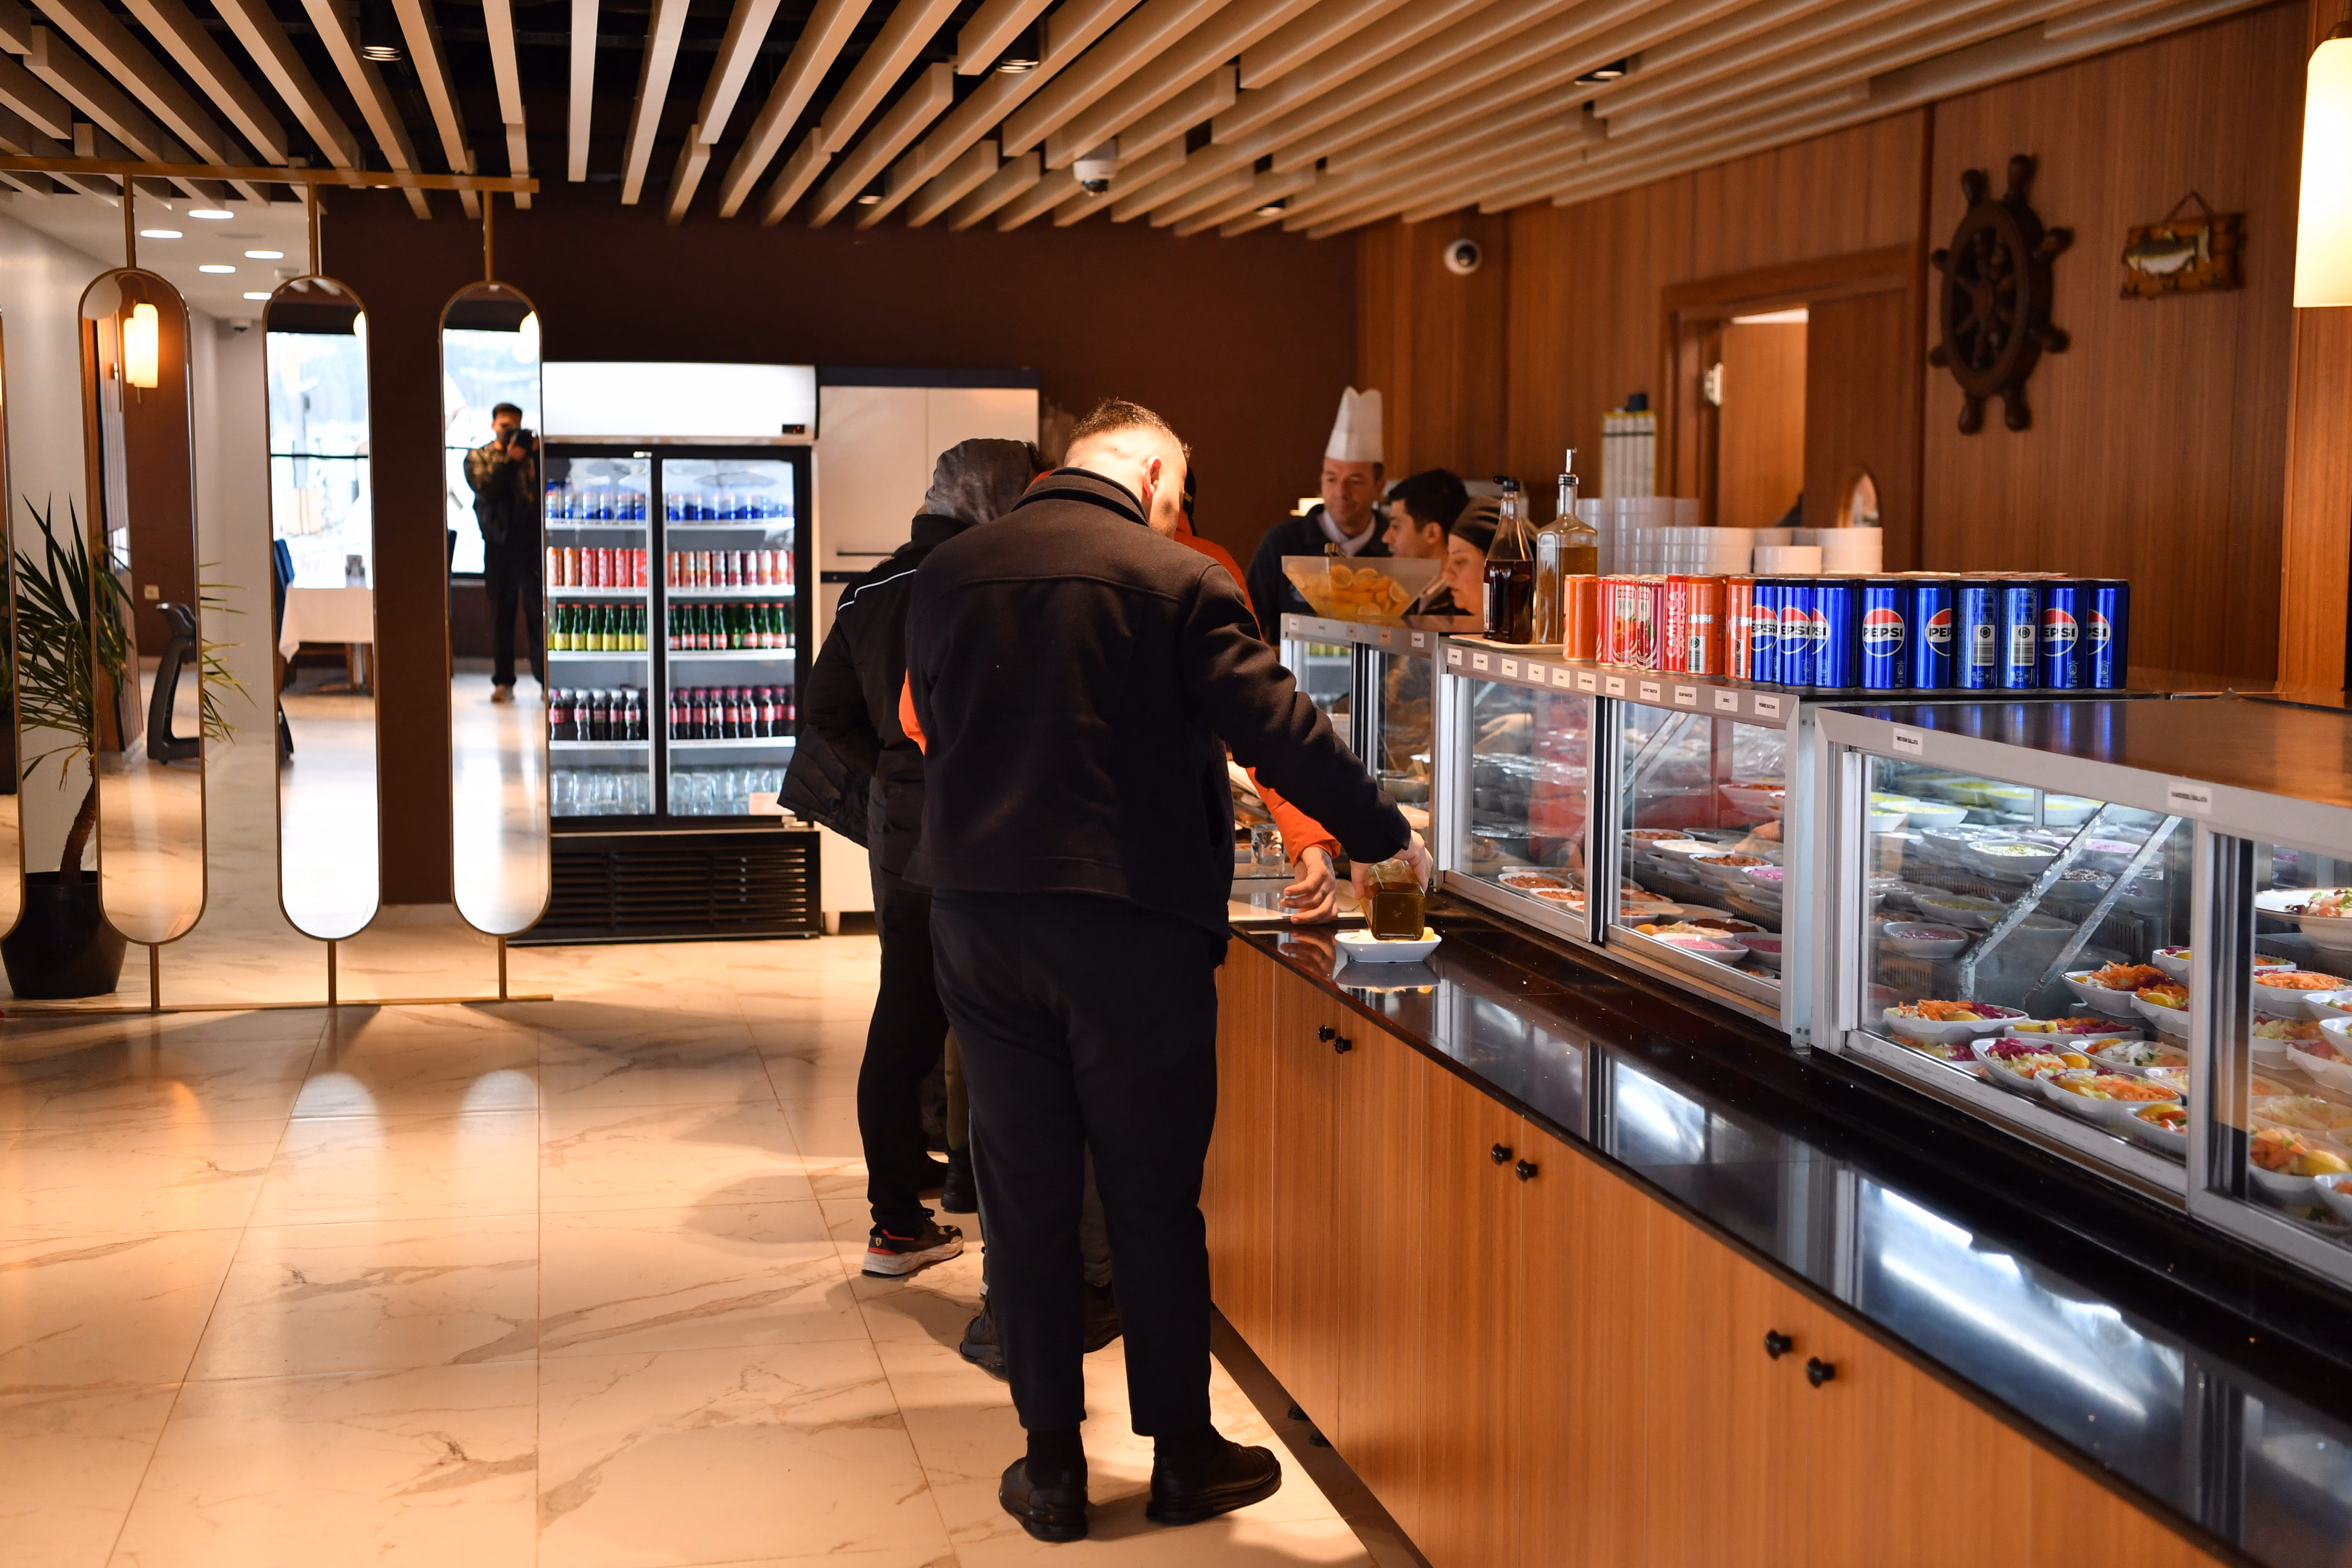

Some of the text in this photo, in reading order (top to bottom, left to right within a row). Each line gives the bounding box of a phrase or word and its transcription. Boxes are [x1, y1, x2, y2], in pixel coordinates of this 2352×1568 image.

[1781, 626, 1810, 635] EPSI
[1863, 627, 1903, 637] PEPSI
[1929, 627, 1951, 637] PEP
[2043, 627, 2075, 637] EPSI
